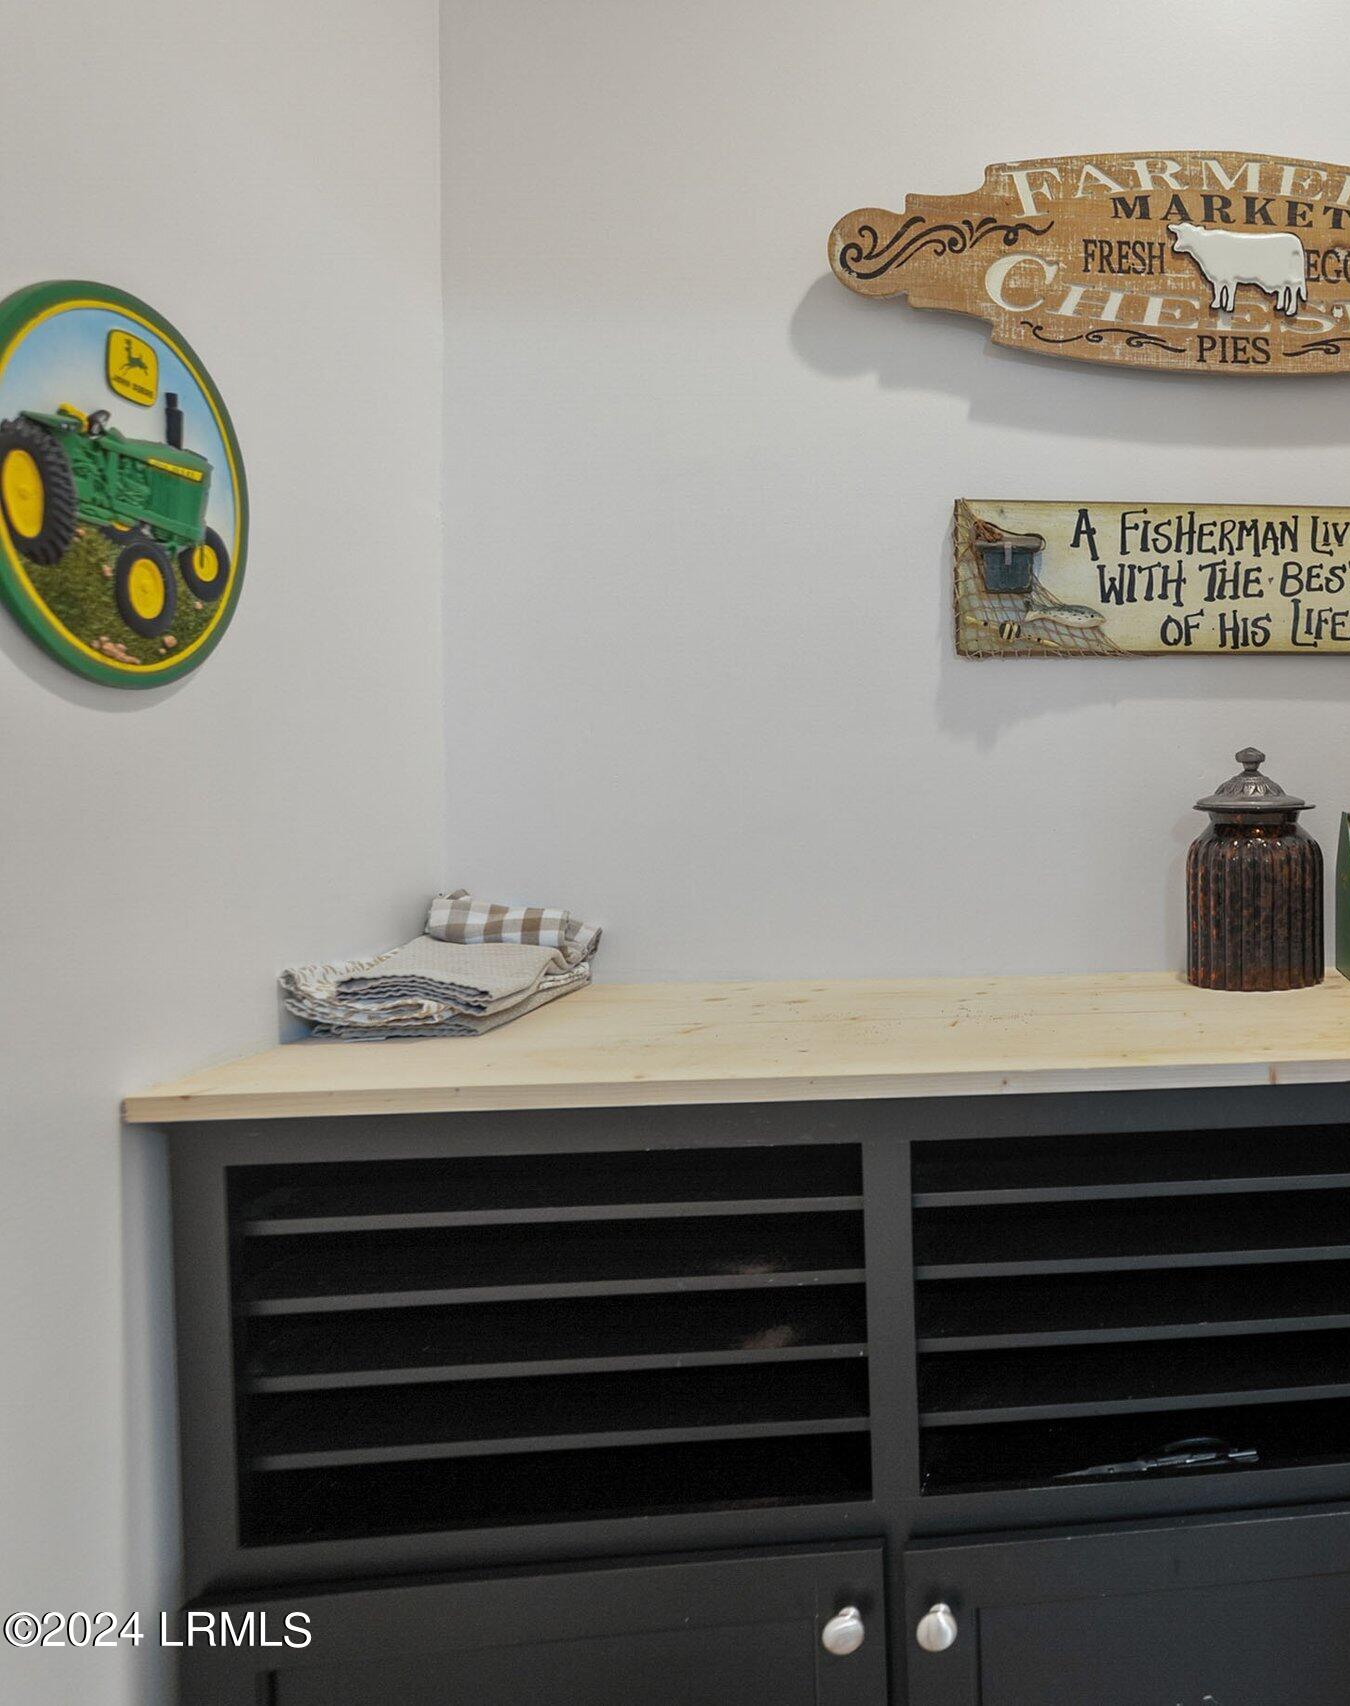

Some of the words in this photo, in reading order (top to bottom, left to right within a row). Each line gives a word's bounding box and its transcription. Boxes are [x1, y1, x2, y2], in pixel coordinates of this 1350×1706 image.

[1082, 238, 1166, 275] FRESH
[1196, 334, 1271, 364] PIES
[1070, 508, 1099, 561] A
[1120, 508, 1299, 557] FISHERMAN
[1097, 560, 1187, 606] WITH
[1199, 559, 1264, 602] THE
[1160, 609, 1204, 646] OF
[1218, 610, 1271, 649] HIS
